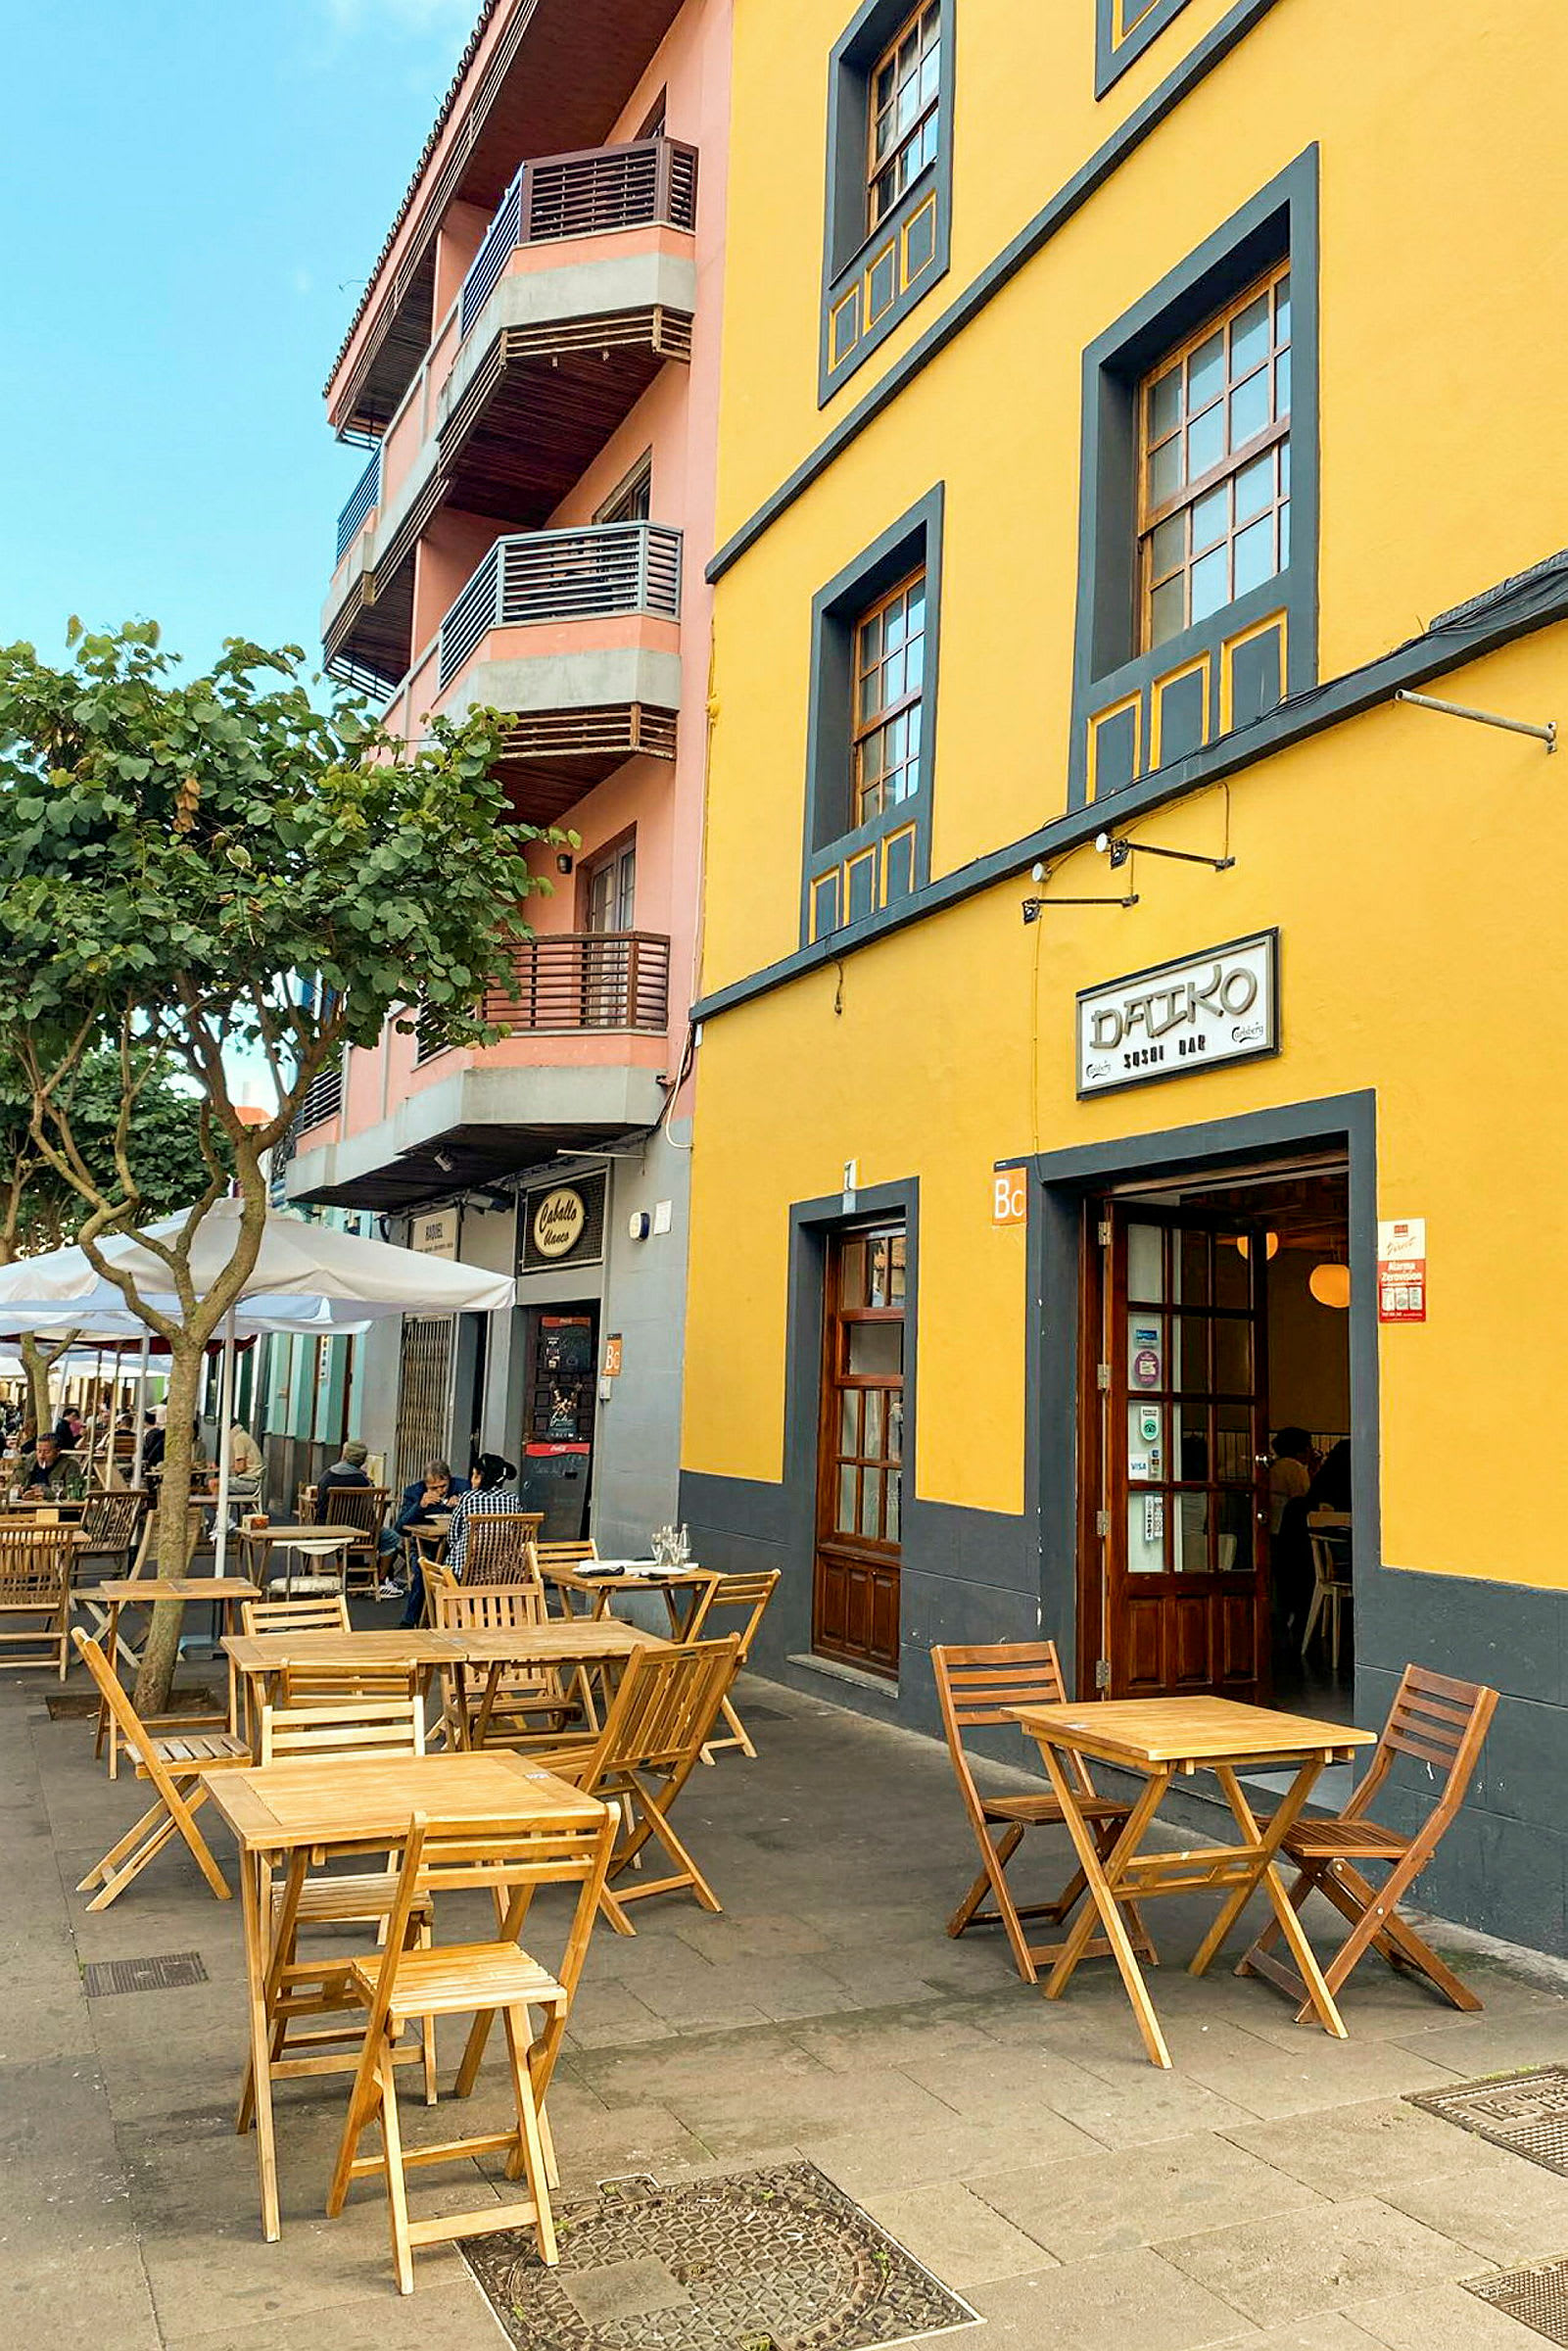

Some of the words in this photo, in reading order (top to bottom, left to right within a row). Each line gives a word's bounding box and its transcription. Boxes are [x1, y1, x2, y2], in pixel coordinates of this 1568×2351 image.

[1089, 964, 1258, 1049] DAIKO
[1123, 1045, 1164, 1069] SUSHI
[1179, 1034, 1206, 1055] BAR
[539, 1198, 577, 1233] Caballo
